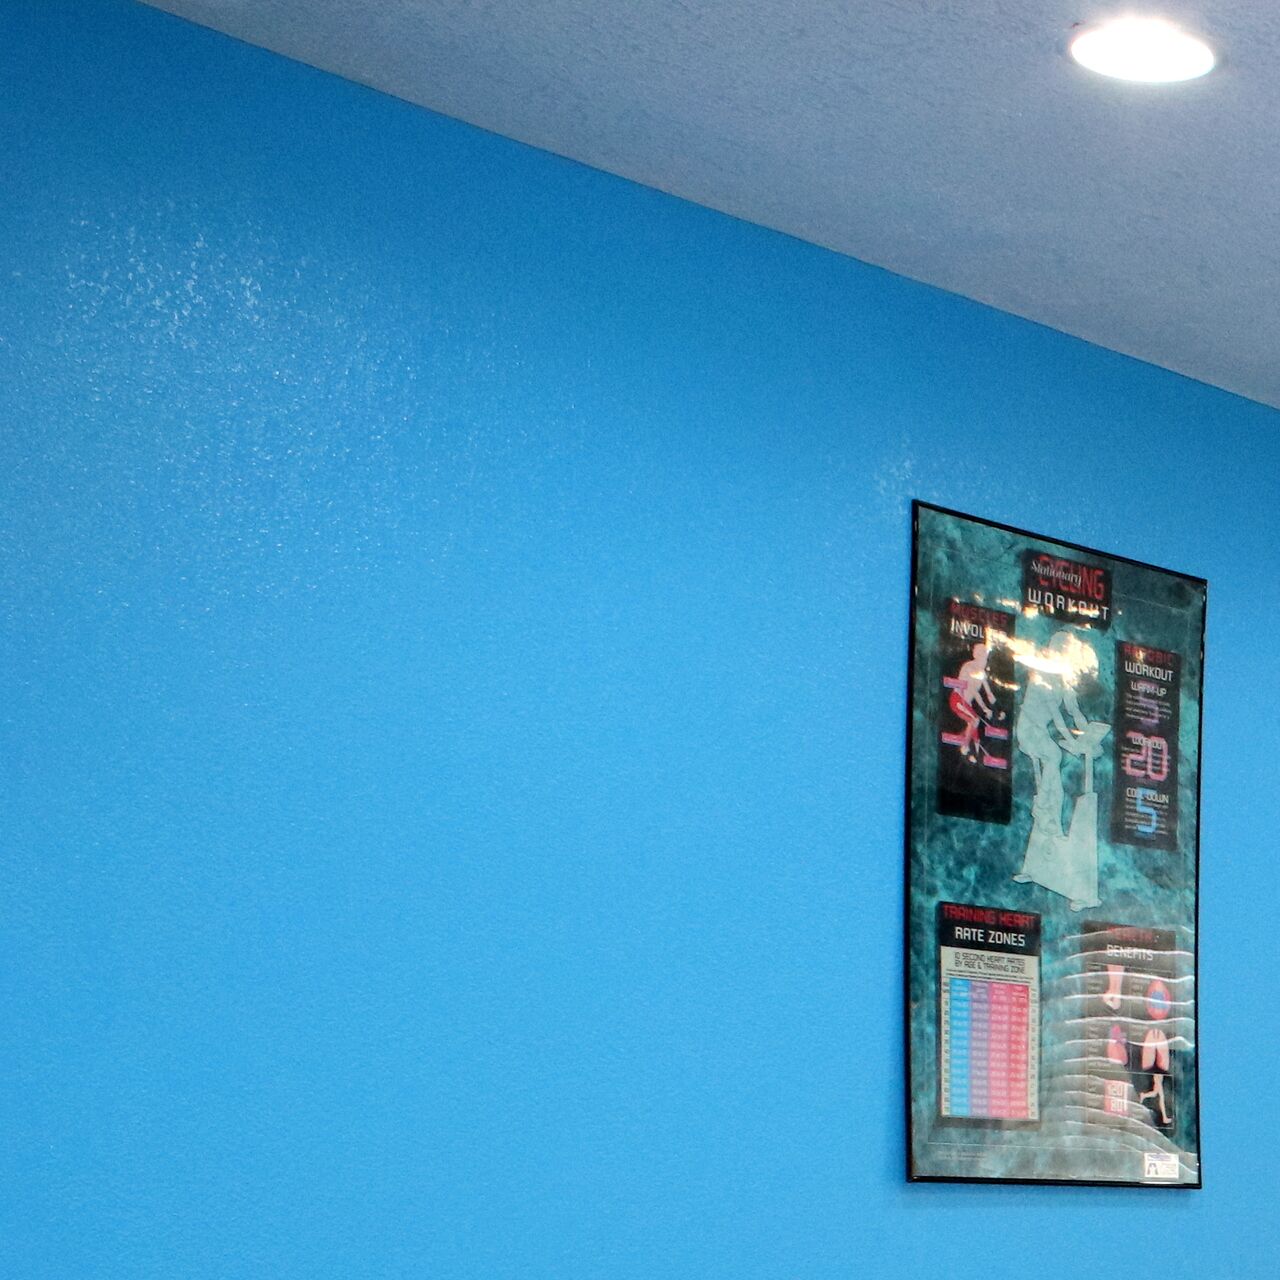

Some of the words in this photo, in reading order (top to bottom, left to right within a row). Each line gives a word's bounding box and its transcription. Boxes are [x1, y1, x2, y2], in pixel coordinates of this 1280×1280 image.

[1031, 560, 1082, 588] Stationary
[1028, 587, 1109, 620] WORKOUT
[950, 617, 1007, 642] INVOL
[1122, 643, 1174, 667] AEOBIC
[1125, 660, 1174, 681] WORKOUT
[1121, 731, 1168, 781] 20
[1135, 786, 1157, 836] 5
[955, 926, 985, 943] RATE
[987, 930, 1026, 948] ZONES
[1106, 943, 1154, 961] BENEFITS
